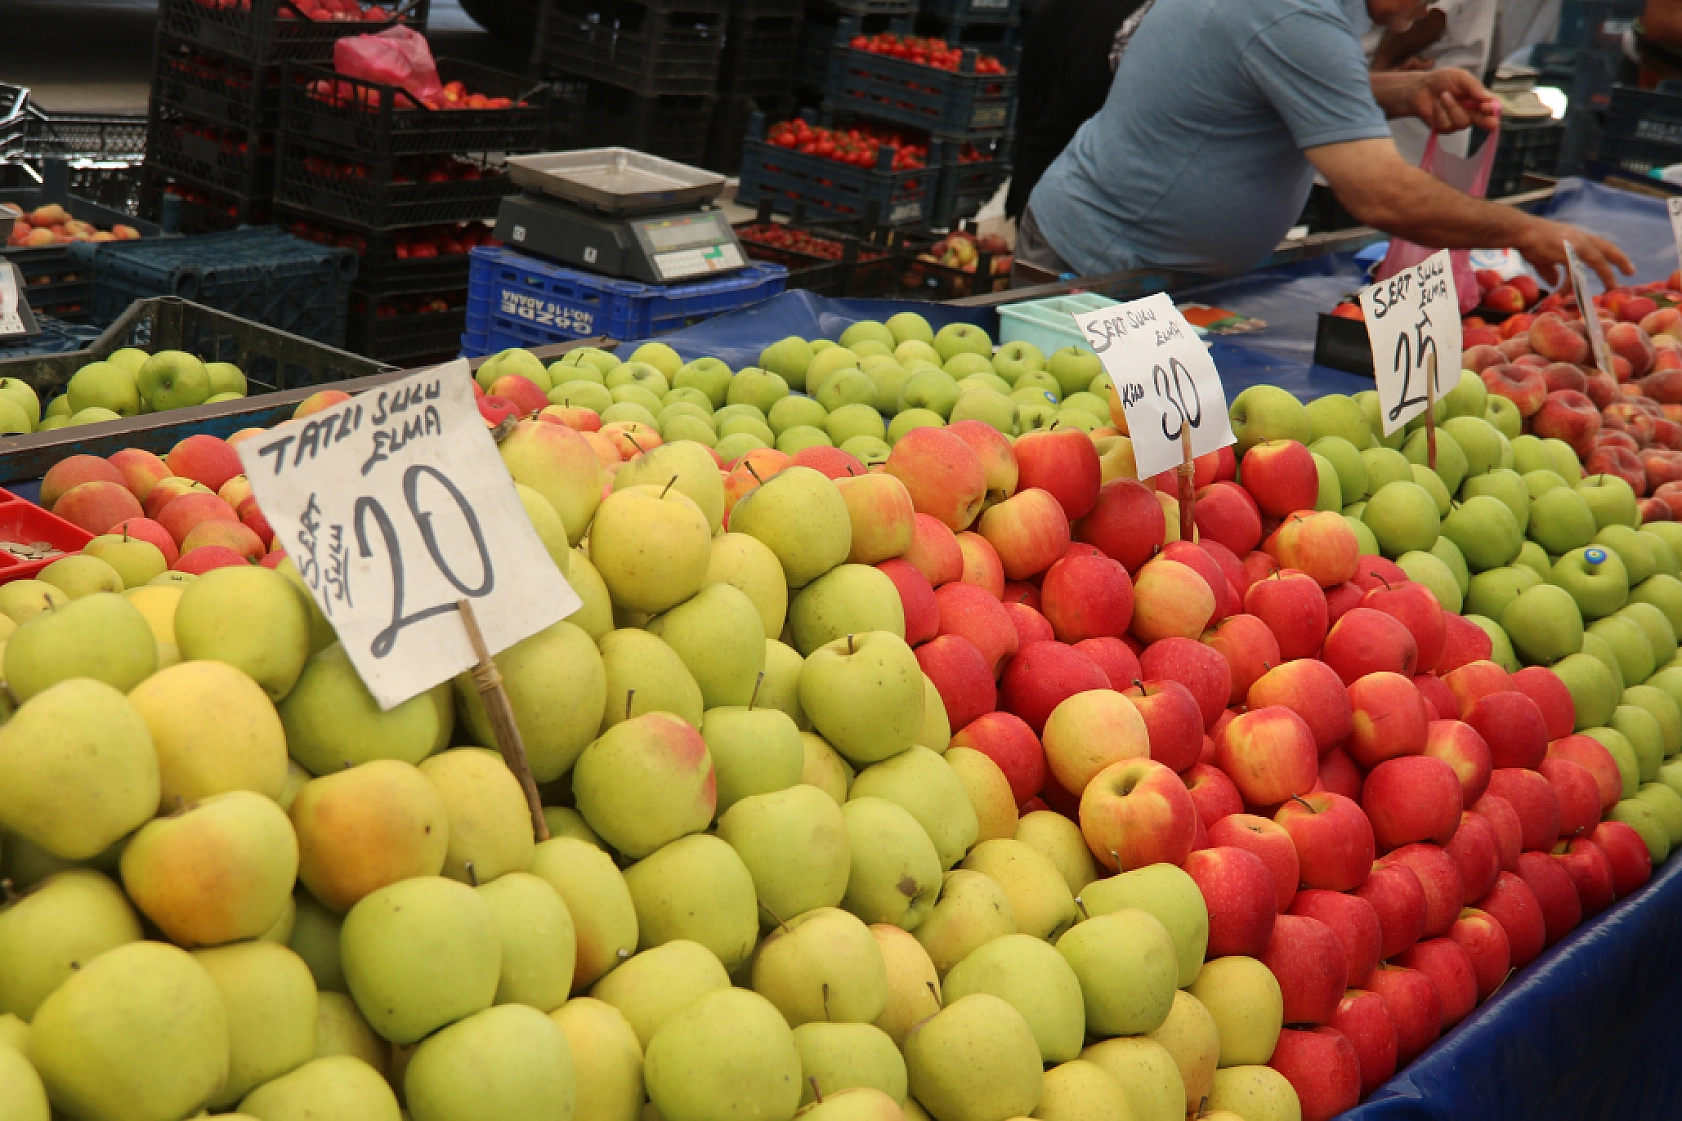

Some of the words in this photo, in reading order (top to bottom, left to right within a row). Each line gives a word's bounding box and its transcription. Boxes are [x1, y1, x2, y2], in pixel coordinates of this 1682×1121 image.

[1372, 273, 1412, 319] SERT
[1416, 260, 1444, 288] SULU
[1418, 279, 1449, 310] ELMA
[1086, 317, 1128, 353] SERT
[1126, 308, 1157, 329] SULU
[1155, 321, 1184, 347] ELMA
[1389, 309, 1440, 421] 25
[258, 404, 363, 475] TATLI
[371, 379, 441, 426] SULU
[1153, 357, 1201, 441] 30
[361, 405, 441, 476] ELMA
[298, 492, 322, 590] SERT
[353, 464, 495, 659] 20
